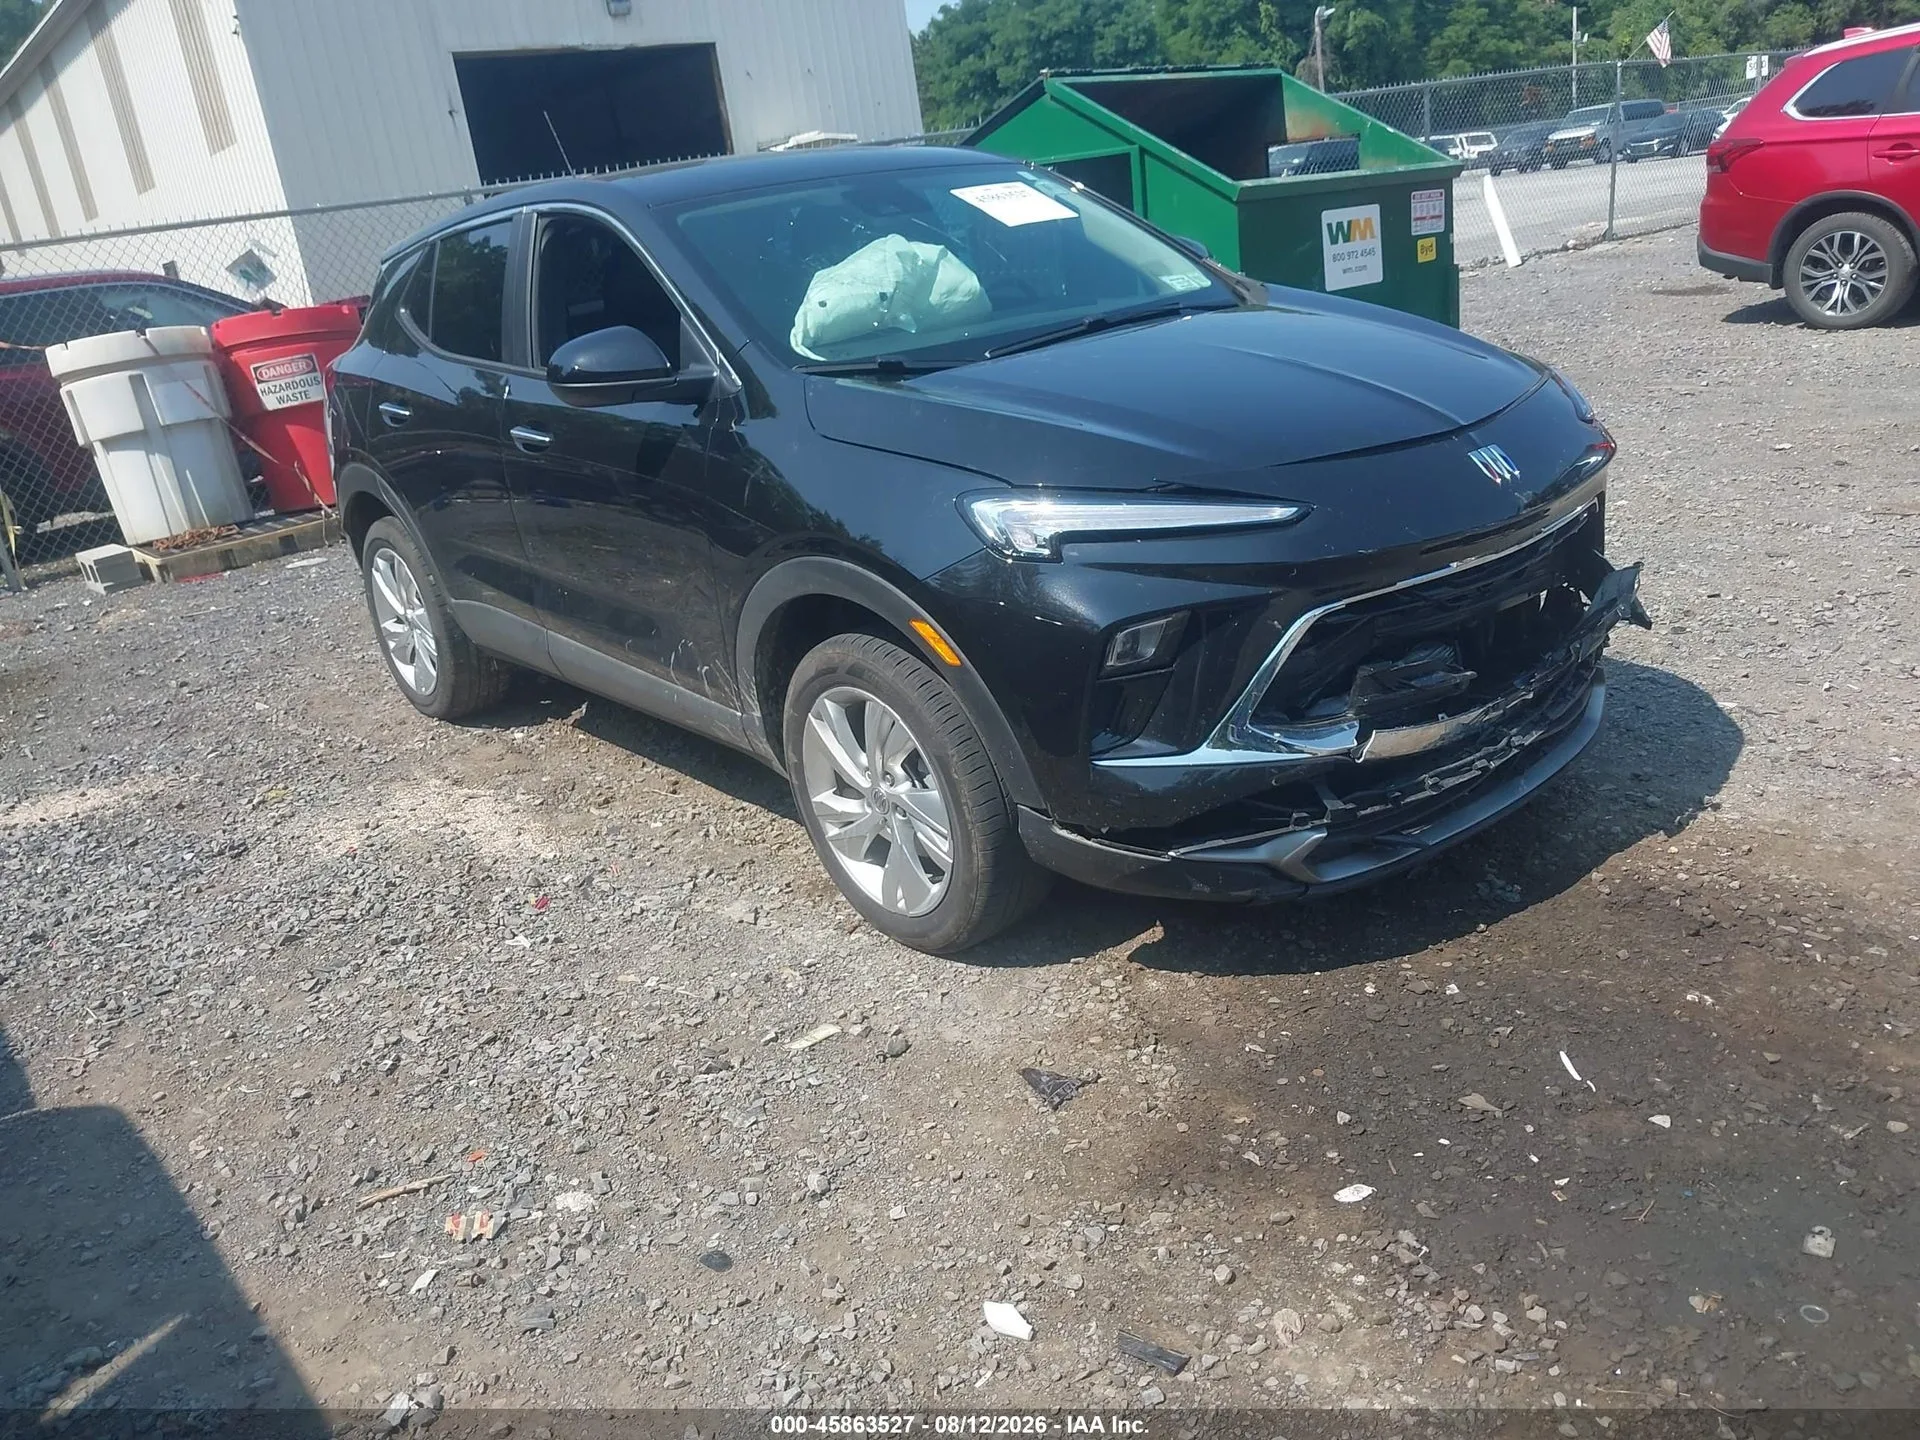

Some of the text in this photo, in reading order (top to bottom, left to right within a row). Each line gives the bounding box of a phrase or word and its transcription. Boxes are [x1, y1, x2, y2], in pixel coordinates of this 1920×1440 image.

[1326, 216, 1376, 245] WM
[1332, 252, 1346, 263] 800
[1346, 249, 1359, 260] 972
[1342, 264, 1368, 274] wm.com
[261, 361, 308, 379] DANGER
[260, 376, 321, 397] HAZARDOUS
[275, 390, 311, 405] WASTE
